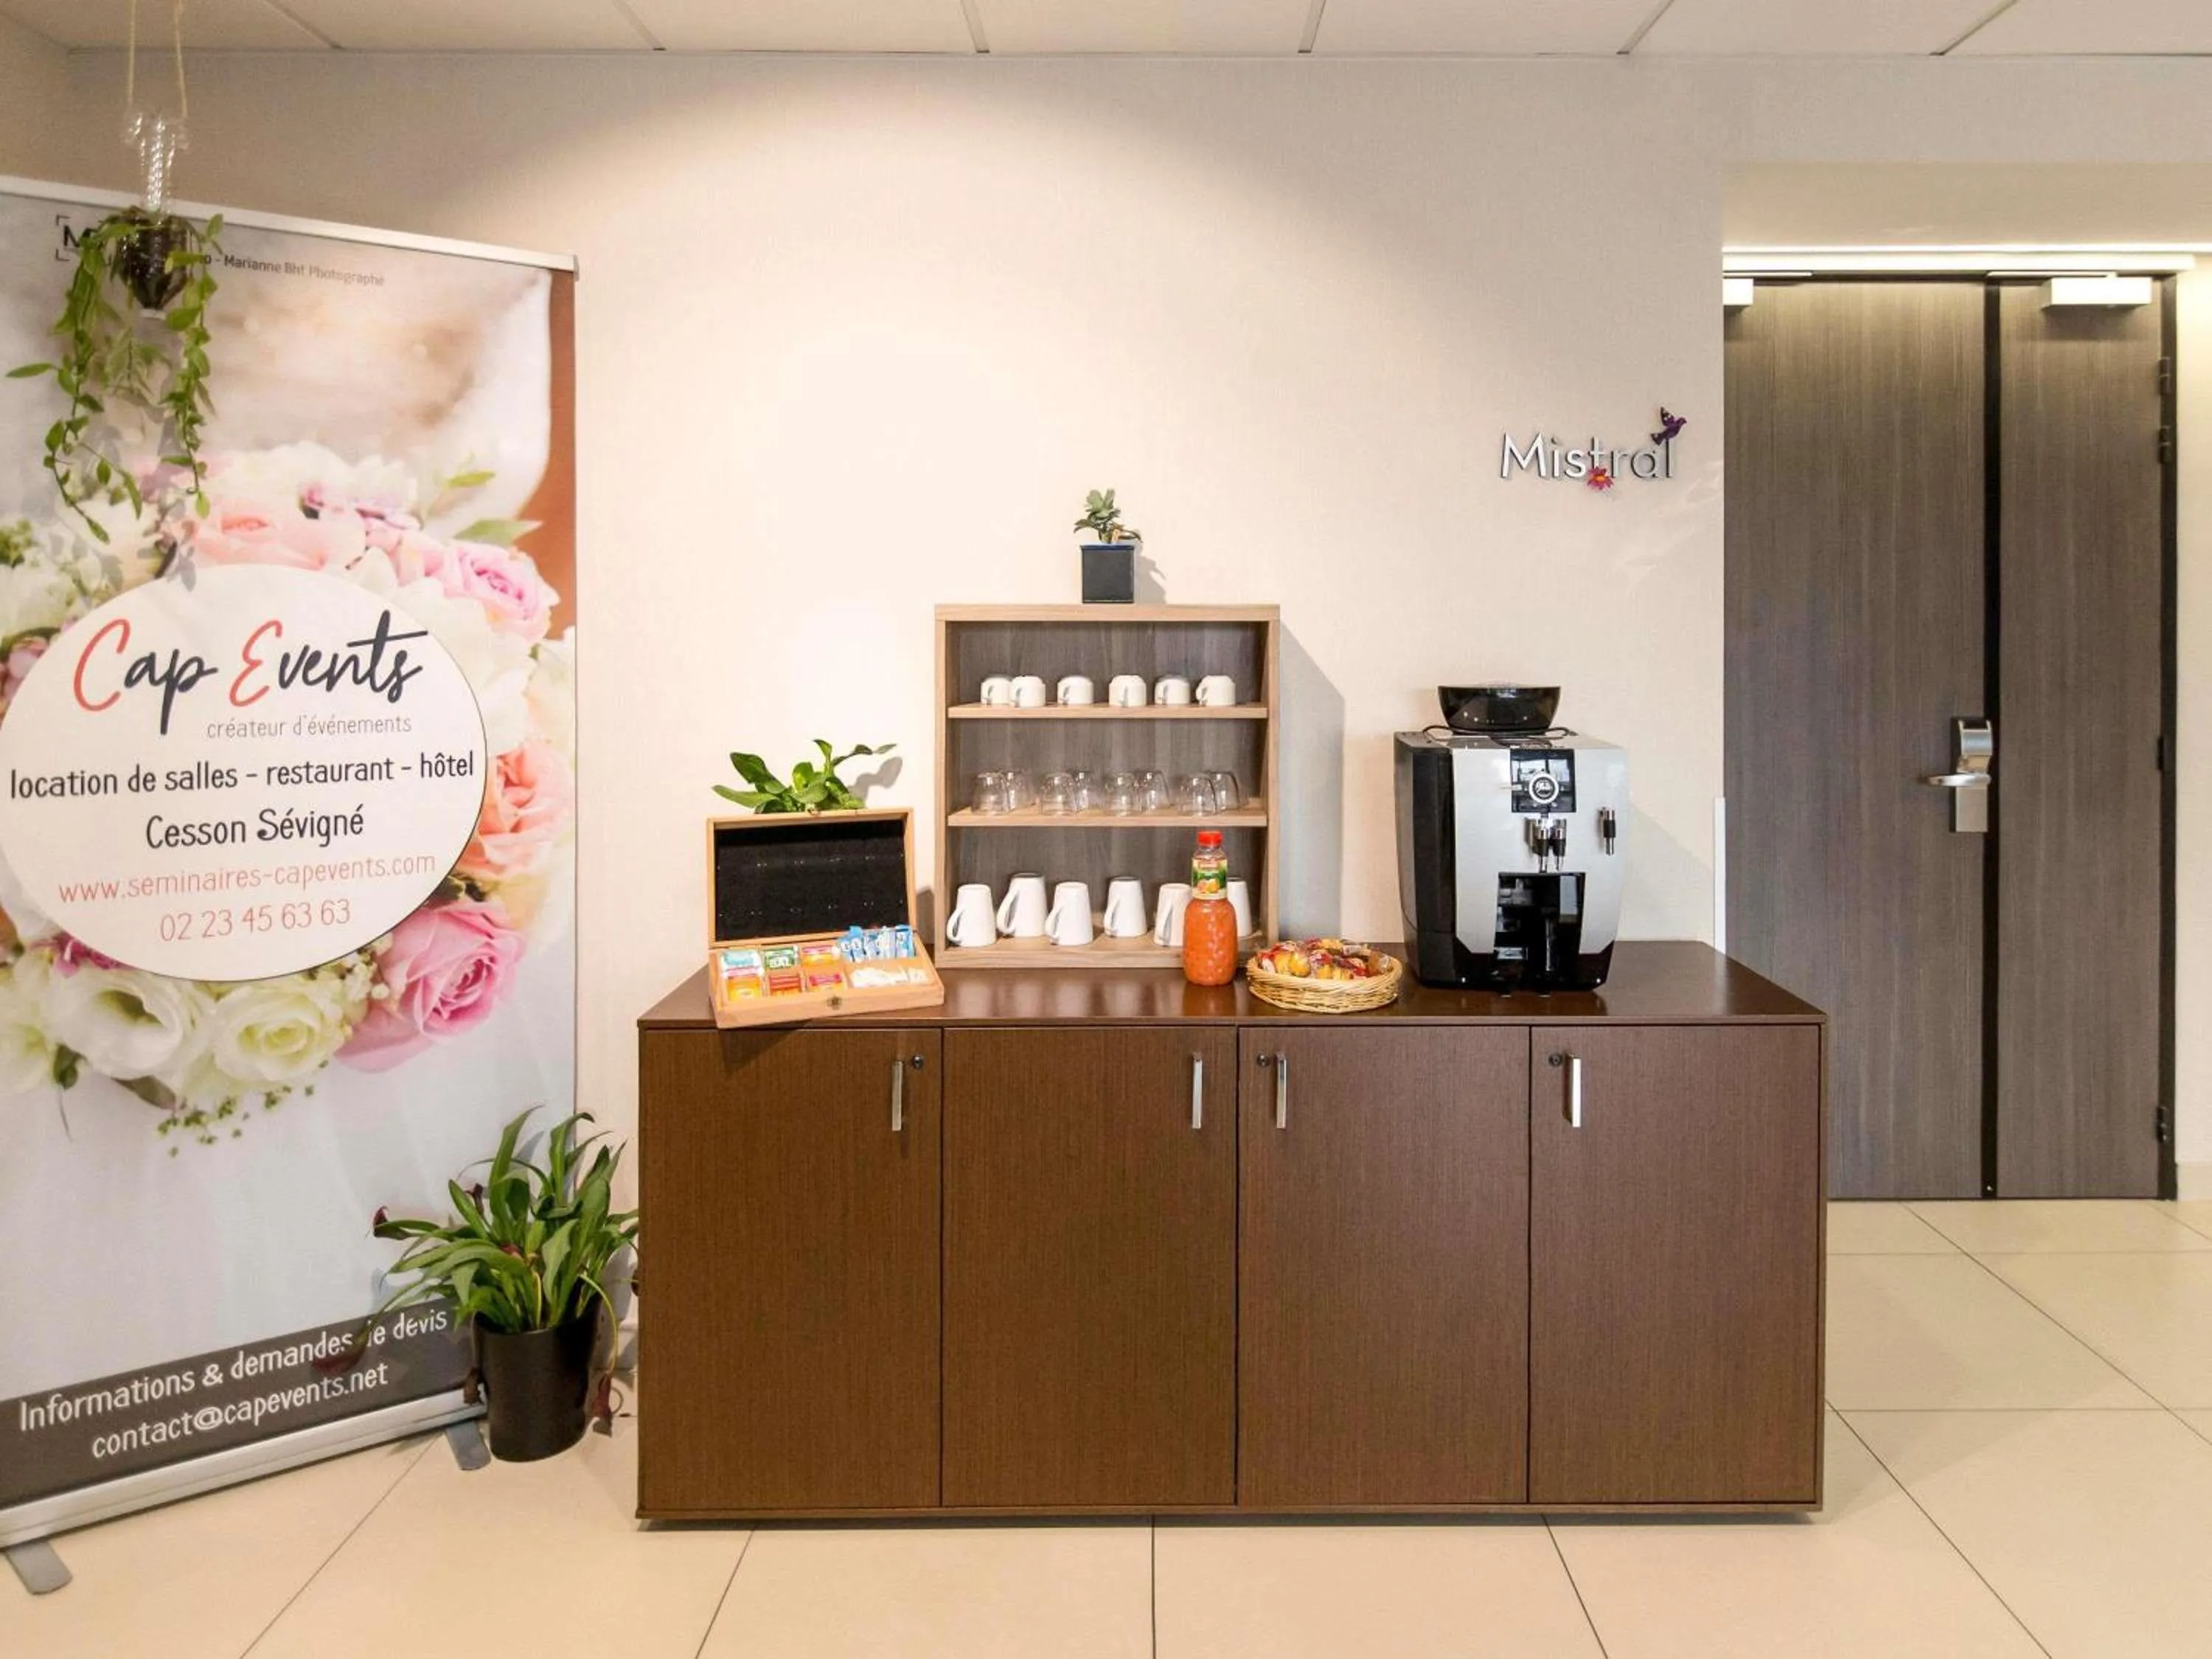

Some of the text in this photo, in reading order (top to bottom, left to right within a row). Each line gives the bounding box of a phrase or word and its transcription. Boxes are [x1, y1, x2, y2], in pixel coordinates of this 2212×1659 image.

[223, 254, 282, 274] Marianne
[308, 264, 385, 287] Photographe
[1500, 431, 1673, 480] Mistral
[73, 609, 429, 736] Cap Events
[206, 713, 412, 740] créateur d'événements
[10, 768, 119, 800] location
[127, 763, 156, 793] de
[164, 760, 238, 791] salles
[266, 757, 395, 786] restaurant
[420, 750, 474, 779] hôtel
[145, 803, 364, 849] Cesson Sévigné
[58, 855, 437, 904] www.seminaires-capevents.com
[159, 897, 352, 942] 02 23 45 63 63
[20, 1370, 195, 1432] Informations
[201, 1363, 224, 1387] &
[229, 1330, 354, 1380] demandes
[392, 1309, 449, 1341] devis
[91, 1362, 389, 1459] contact@capevents.net
